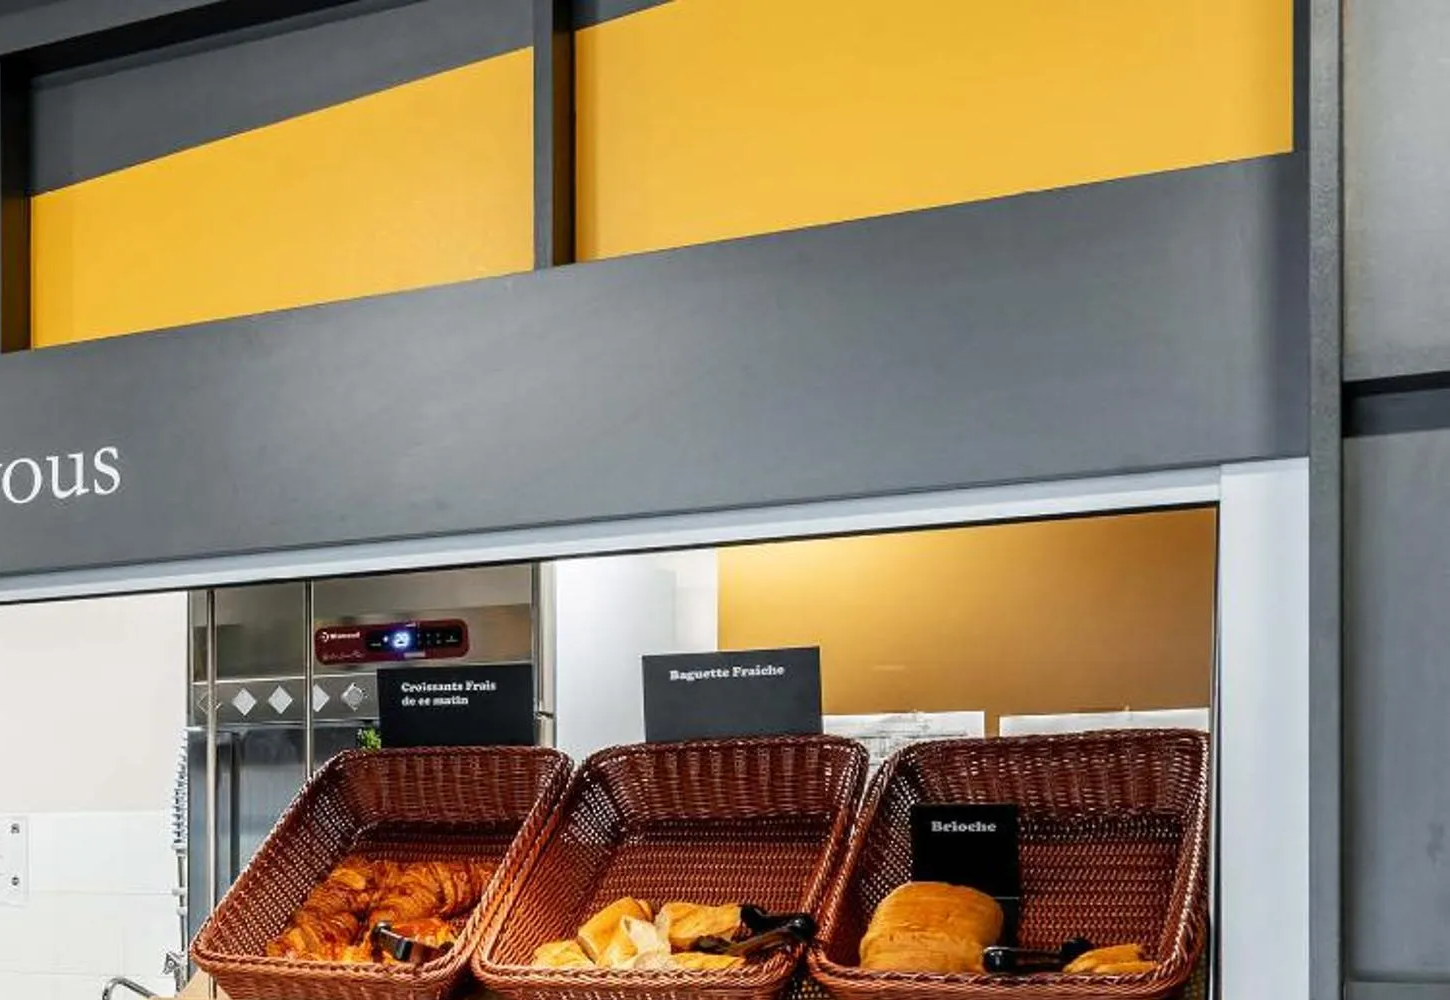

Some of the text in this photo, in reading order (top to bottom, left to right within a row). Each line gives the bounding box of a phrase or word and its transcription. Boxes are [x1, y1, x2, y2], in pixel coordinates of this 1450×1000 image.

[669, 667, 730, 682] Baguette
[400, 679, 498, 693] Croissants Frais
[401, 695, 416, 707] de
[432, 694, 470, 706] matin
[931, 820, 998, 833] Brioche
